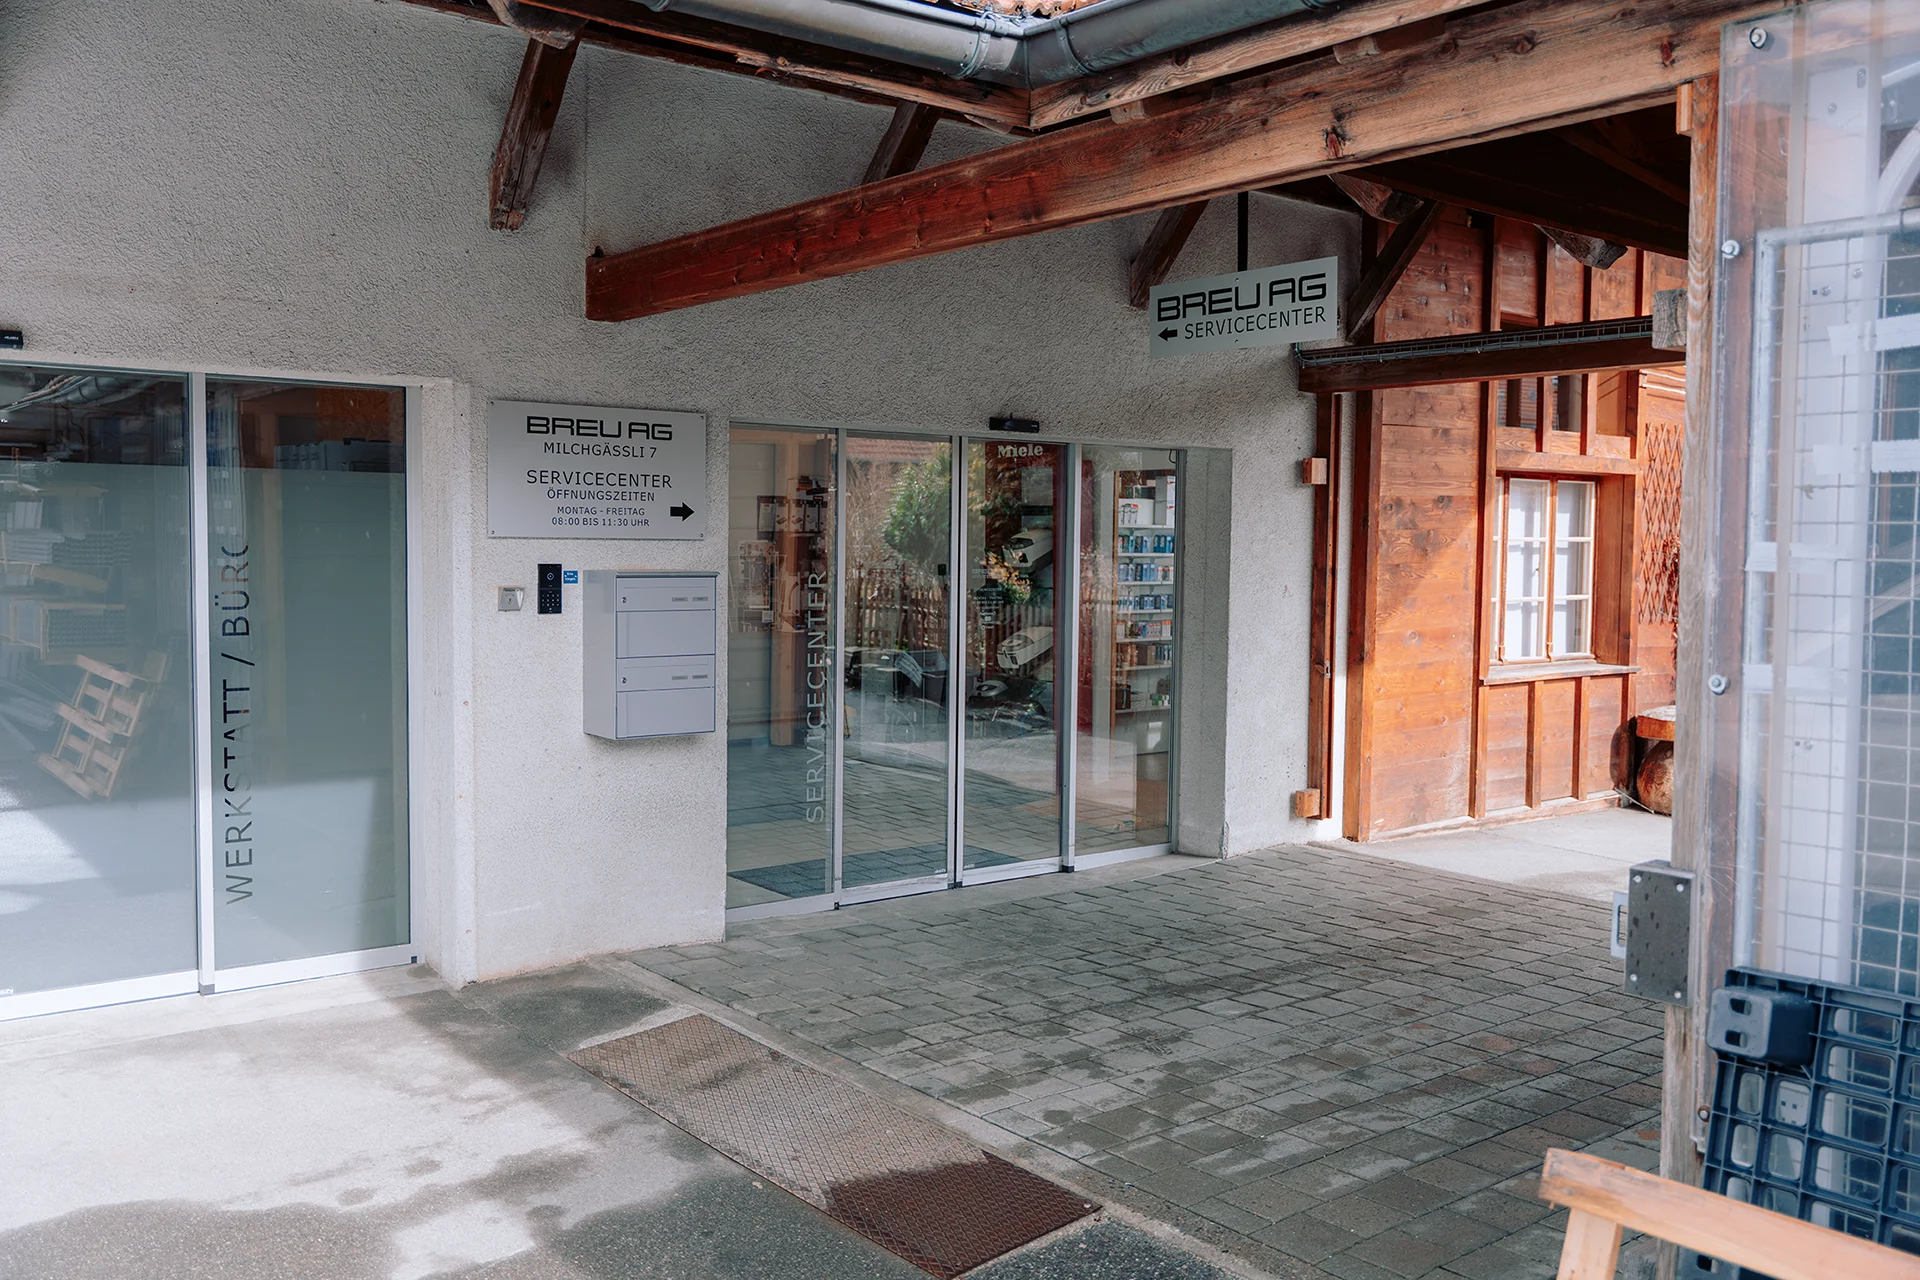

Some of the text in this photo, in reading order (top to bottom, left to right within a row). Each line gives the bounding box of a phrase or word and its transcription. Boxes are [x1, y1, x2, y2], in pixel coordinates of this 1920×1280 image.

[1157, 272, 1327, 322] BREU AG
[1184, 306, 1327, 339] SERVICECENTER
[526, 415, 672, 441] BREU AG
[543, 441, 657, 458] MILCHGÄSSLI 7
[997, 443, 1043, 458] Miele
[526, 469, 672, 488] SERVICECENTER
[546, 487, 655, 501] ÖFFNUNGSZEITEN
[557, 506, 597, 515] MONTAG
[606, 507, 645, 516] FREITAG
[552, 516, 650, 527] 08:00 BIS 11:30 UHR
[221, 652, 255, 667] /
[806, 572, 828, 824] SERVICECENTER
[222, 678, 253, 905] WERKSTATT
